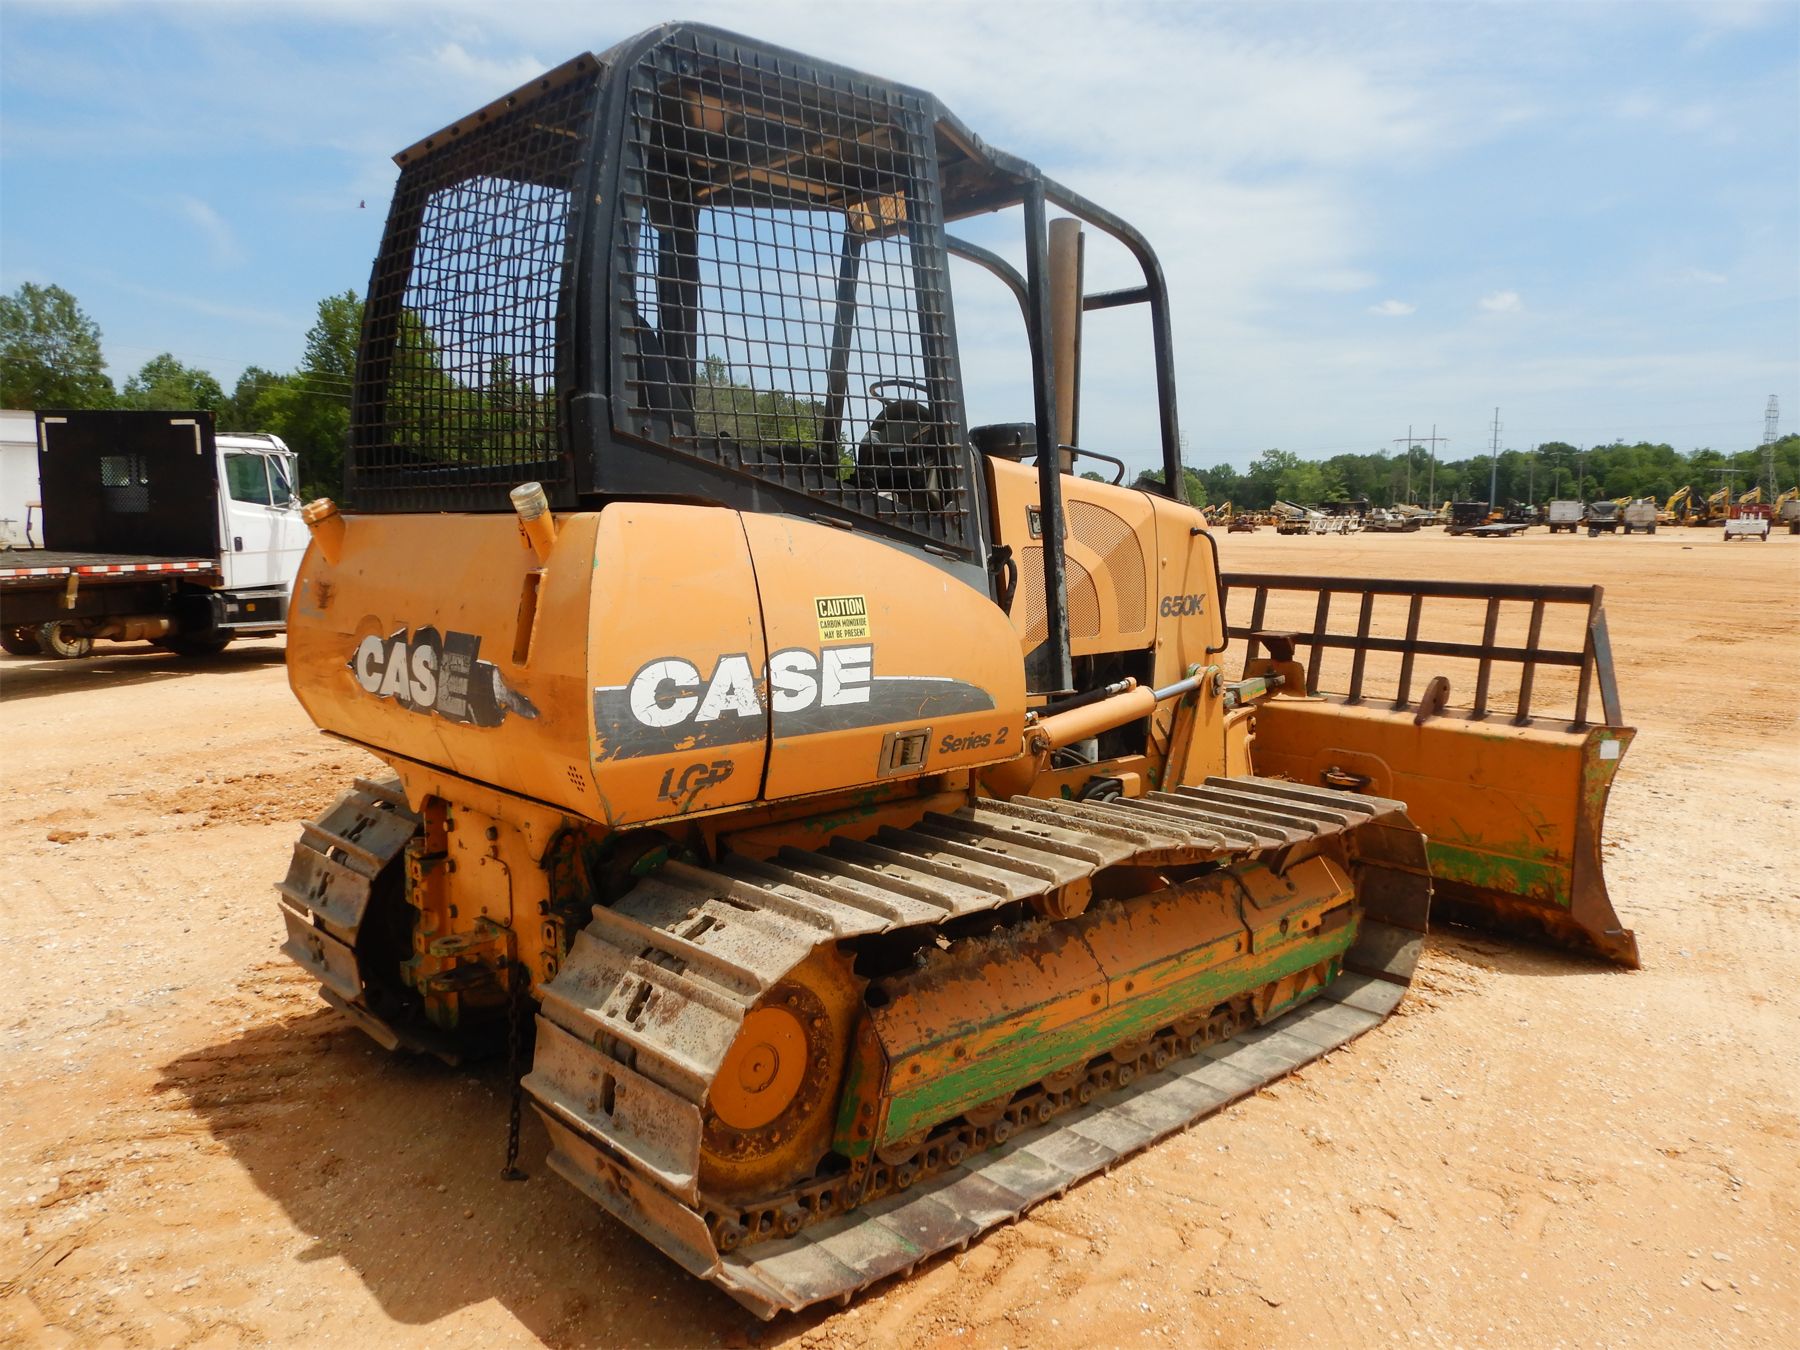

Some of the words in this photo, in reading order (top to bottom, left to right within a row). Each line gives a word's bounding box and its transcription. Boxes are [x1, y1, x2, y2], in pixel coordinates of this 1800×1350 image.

[818, 598, 864, 616] CAUTION
[1160, 593, 1206, 618] 650K
[820, 620, 841, 629] CARBON
[842, 618, 866, 627] MONOXIDE
[824, 630, 834, 639] MAY
[836, 630, 843, 638] BE
[844, 628, 865, 637] PRESENT
[357, 635, 469, 717] CASE
[630, 644, 872, 727] CASE
[939, 734, 990, 754] Series
[994, 727, 1008, 745] 2
[657, 759, 734, 801] LGP
